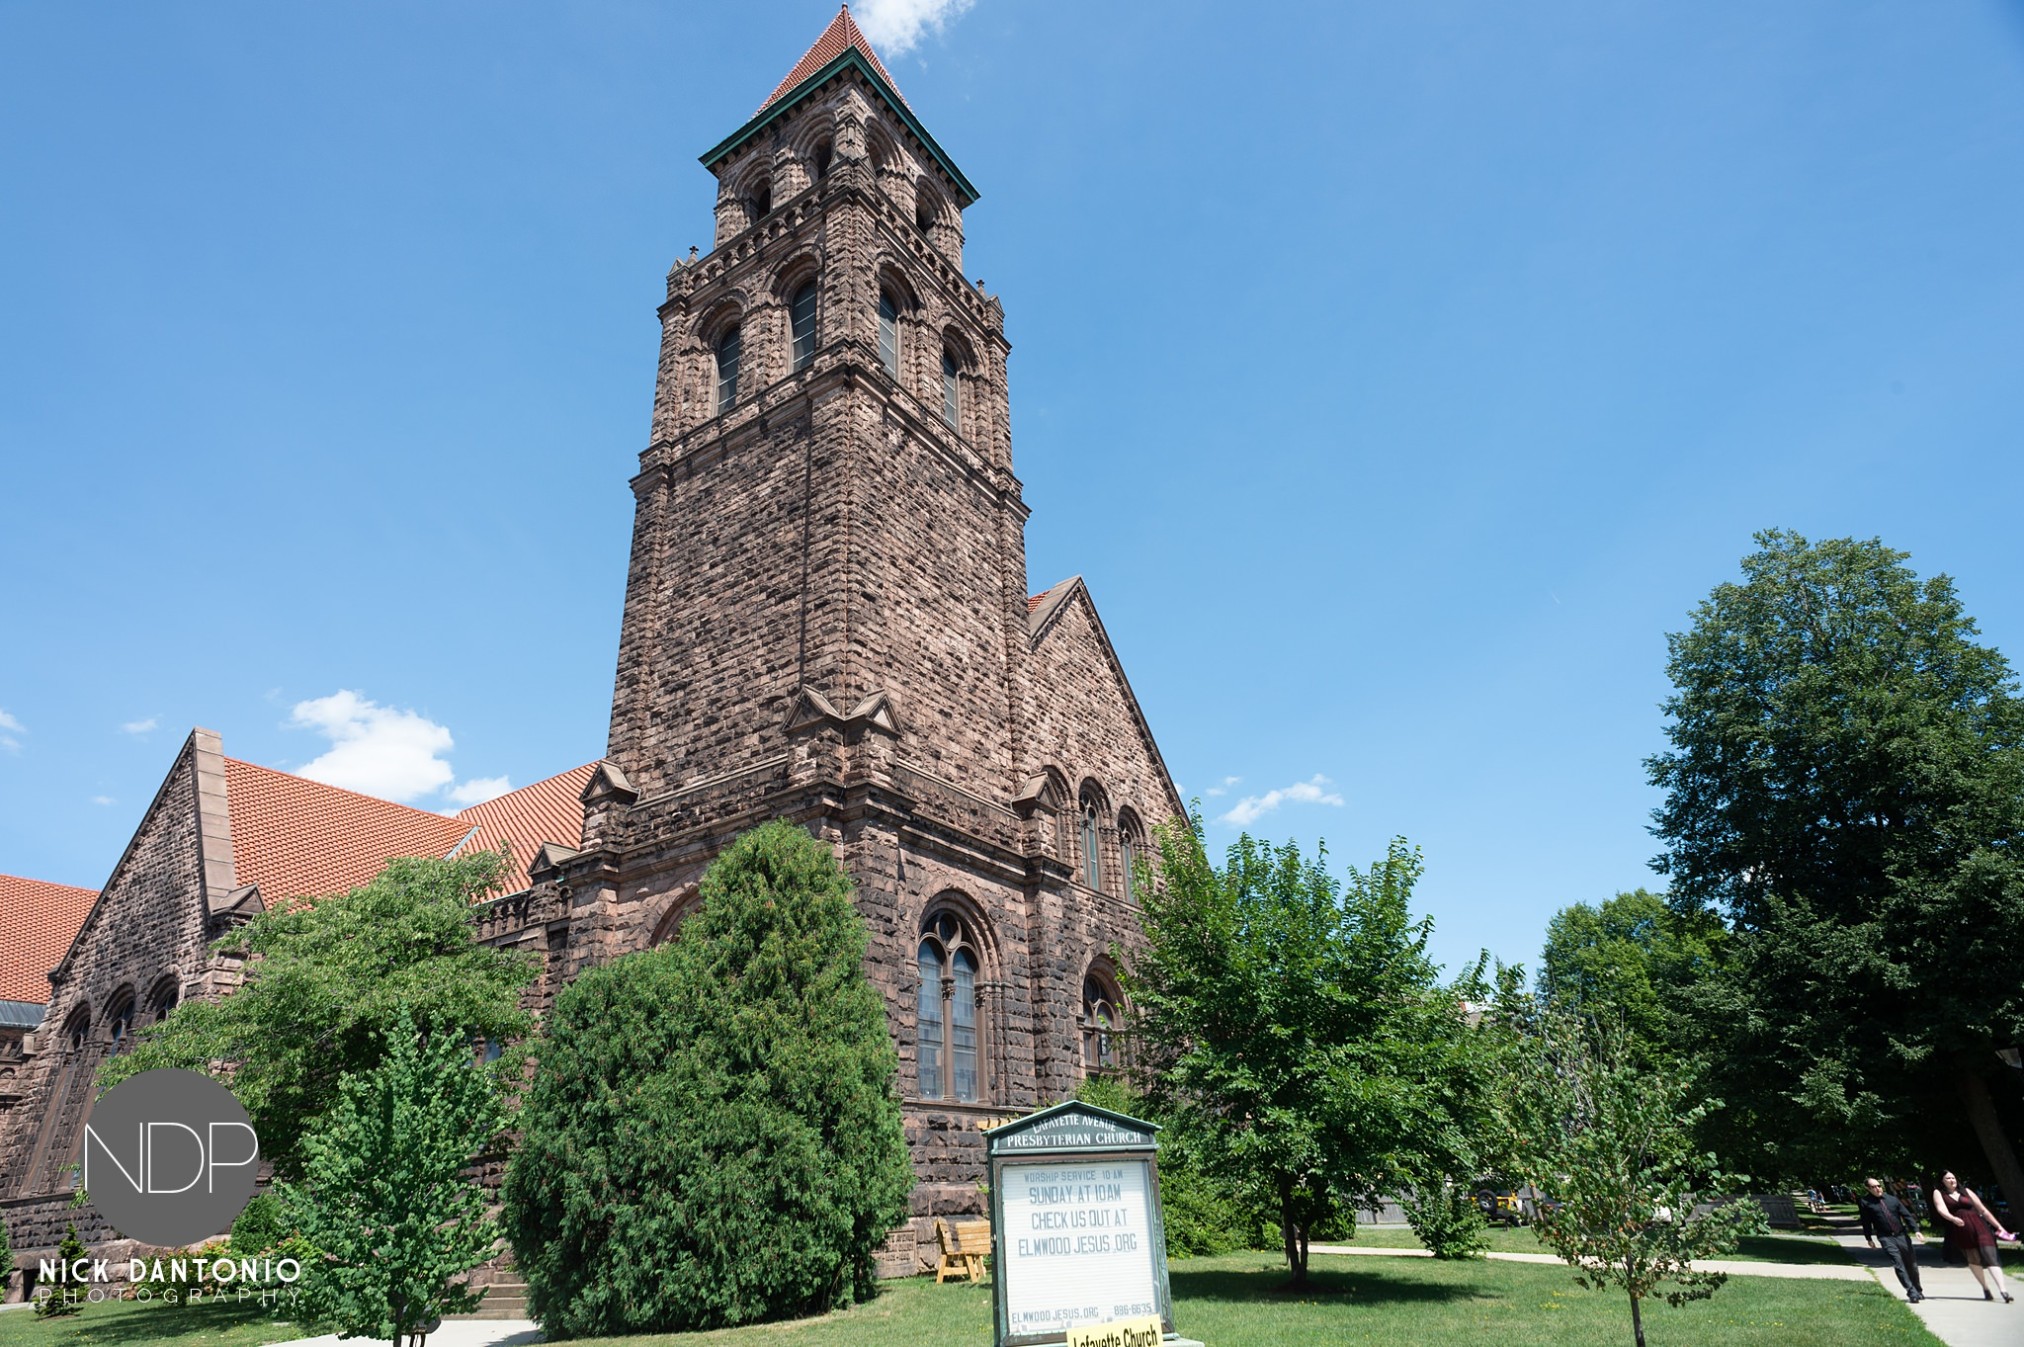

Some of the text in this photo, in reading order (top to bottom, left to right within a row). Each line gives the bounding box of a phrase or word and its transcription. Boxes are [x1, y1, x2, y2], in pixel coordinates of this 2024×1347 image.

[1032, 1115, 1117, 1134] LAFAYETTE AVENUE
[1007, 1132, 1141, 1147] PRESBYTERIAN CHURCH
[1024, 1172, 1059, 1182] WORSHIP
[1061, 1170, 1096, 1181] SERVICE
[1029, 1185, 1073, 1204] SUNDAY
[1077, 1185, 1091, 1203] AT
[1031, 1208, 1128, 1230] CHECK US OUT AT
[1123, 1323, 1158, 1347] Church
